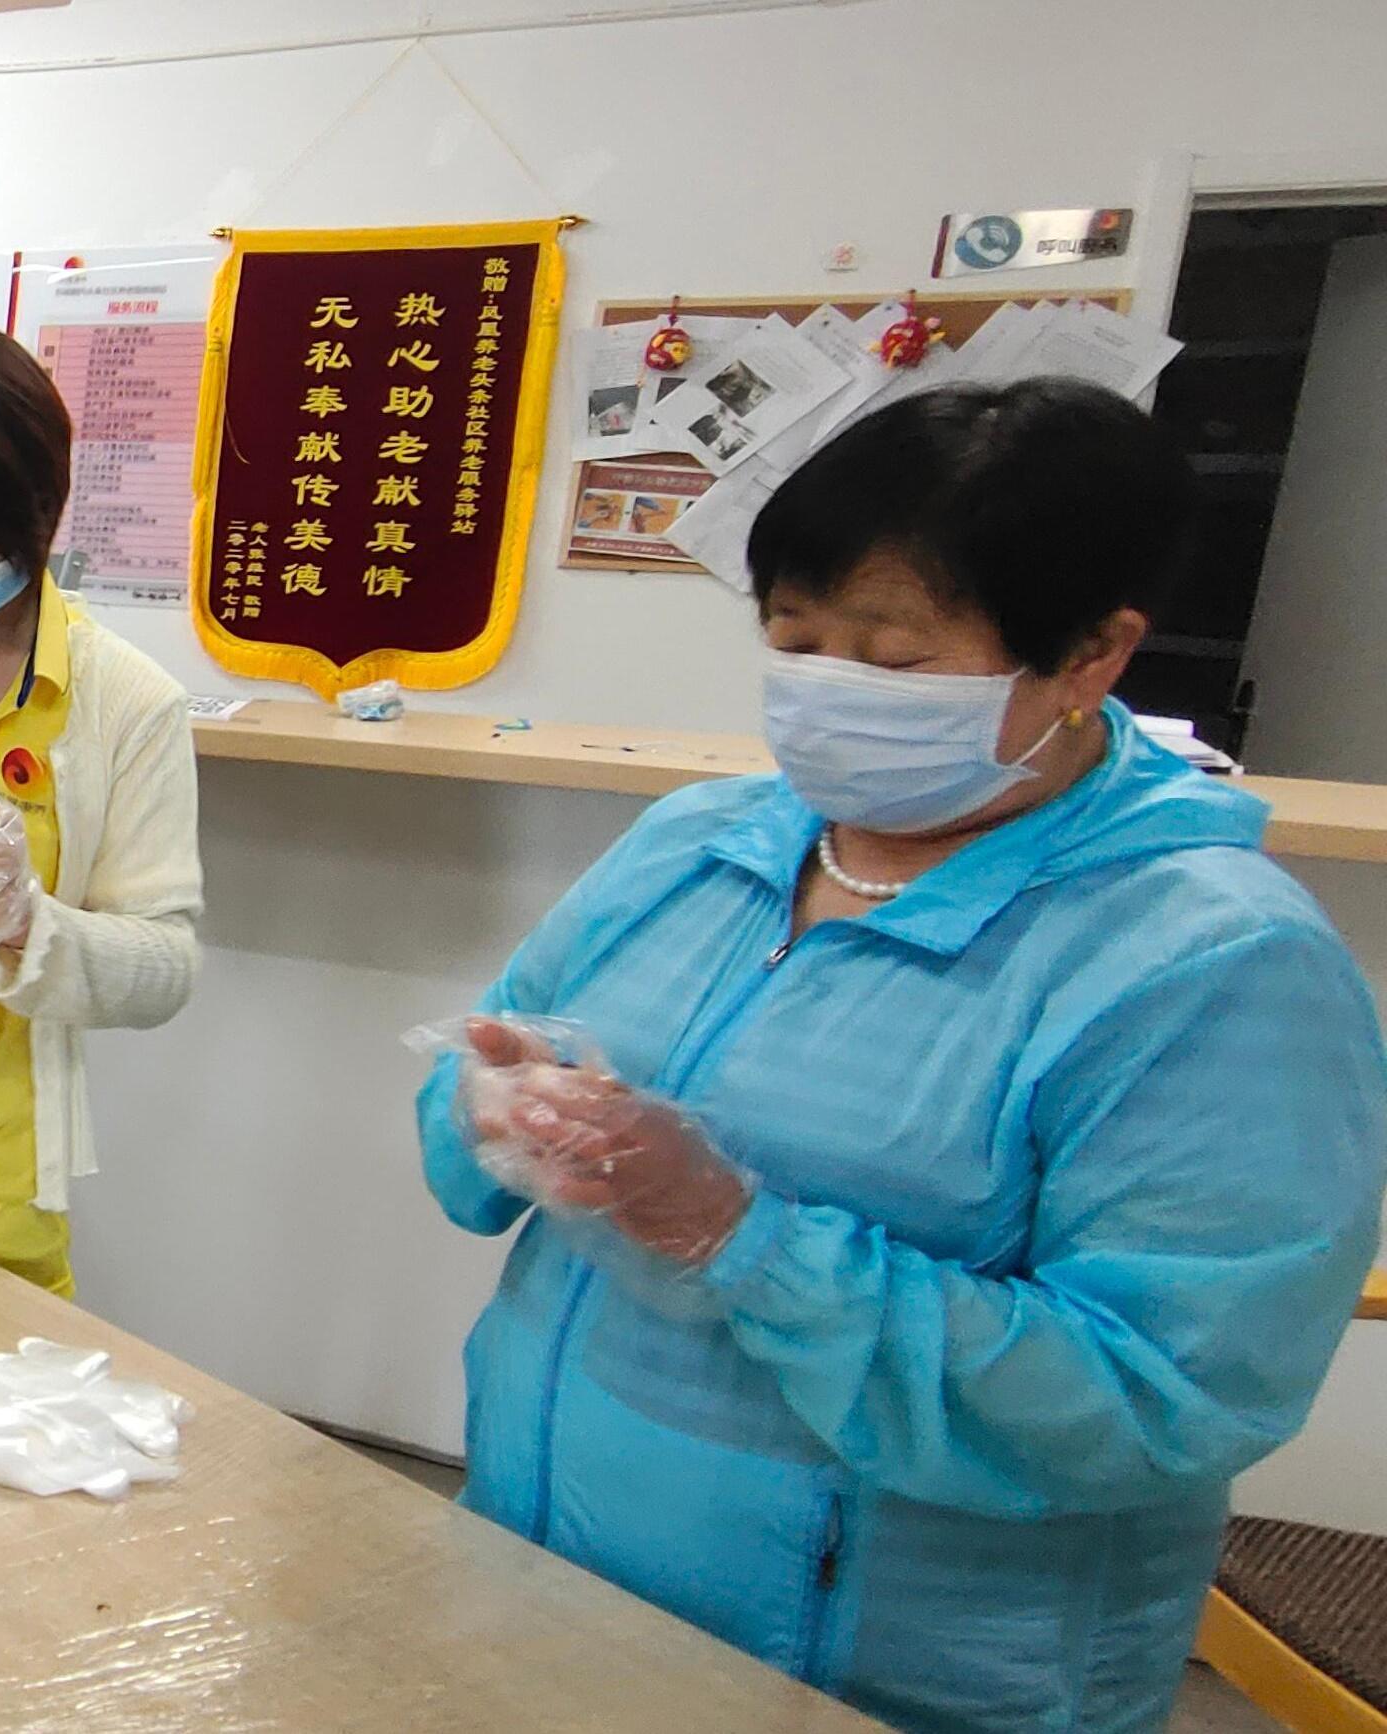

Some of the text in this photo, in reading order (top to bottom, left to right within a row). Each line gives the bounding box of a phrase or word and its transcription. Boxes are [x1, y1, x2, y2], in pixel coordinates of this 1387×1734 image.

[281, 296, 359, 597] 无私奉献传美德
[361, 291, 446, 599] 热心助老献真情
